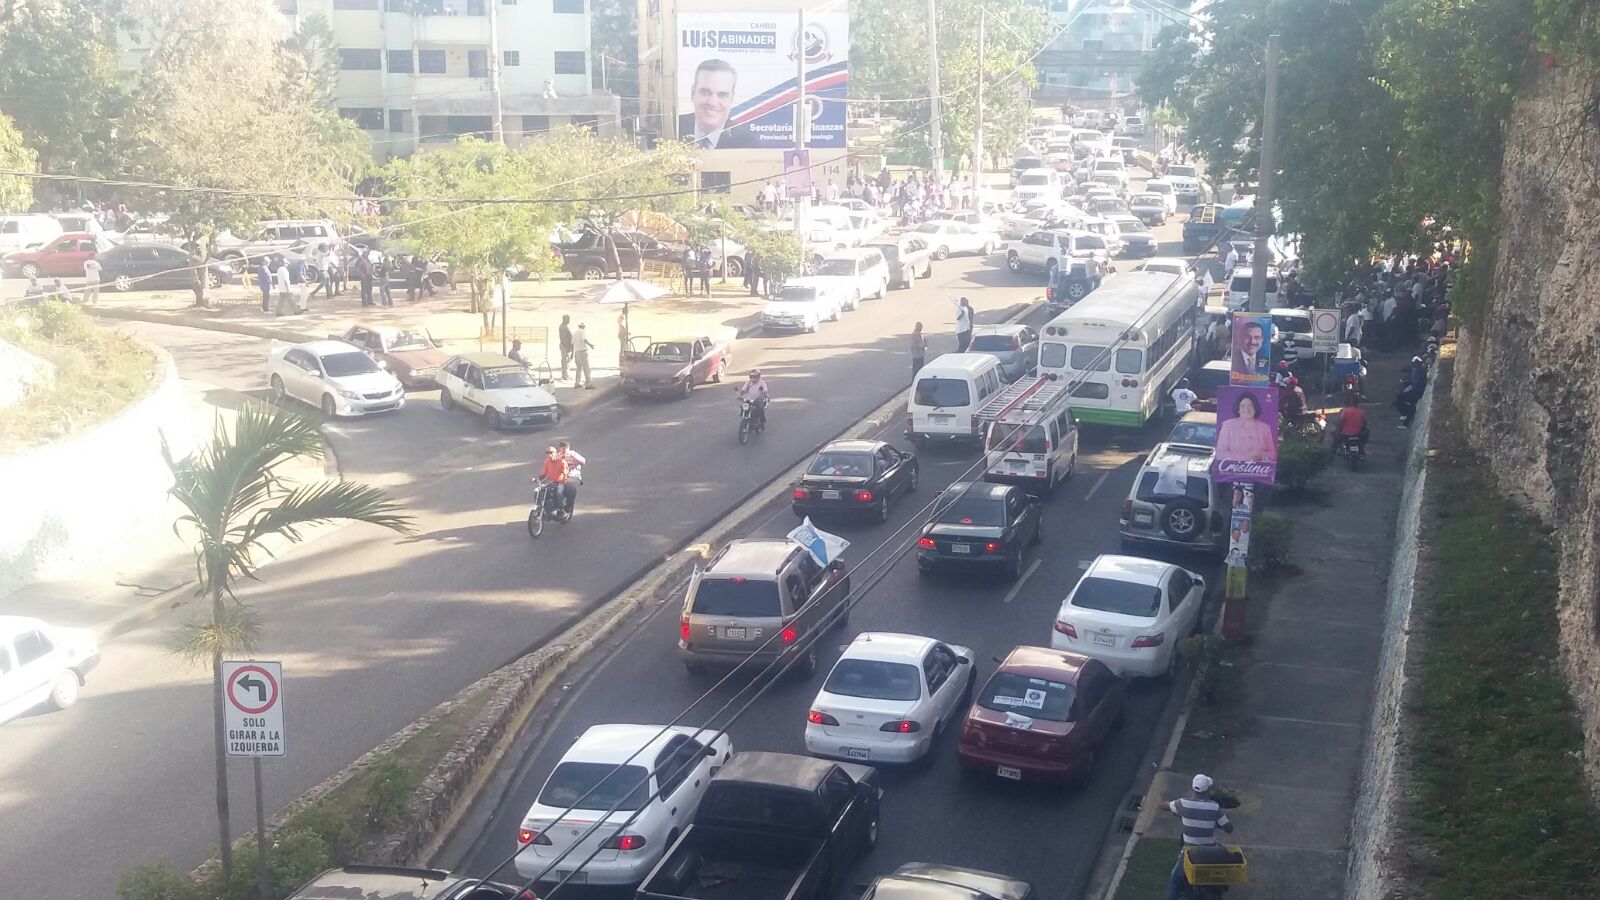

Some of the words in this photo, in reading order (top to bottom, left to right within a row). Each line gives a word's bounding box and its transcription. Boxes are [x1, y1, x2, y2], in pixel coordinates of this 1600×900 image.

[720, 35, 775, 45] ABINADER
[1217, 457, 1272, 474] Cristina
[243, 718, 266, 727] SOLO
[229, 730, 257, 740] GIRAR
[260, 731, 266, 740] A
[269, 731, 280, 740] LA
[230, 742, 279, 752] IZQUIERDA
